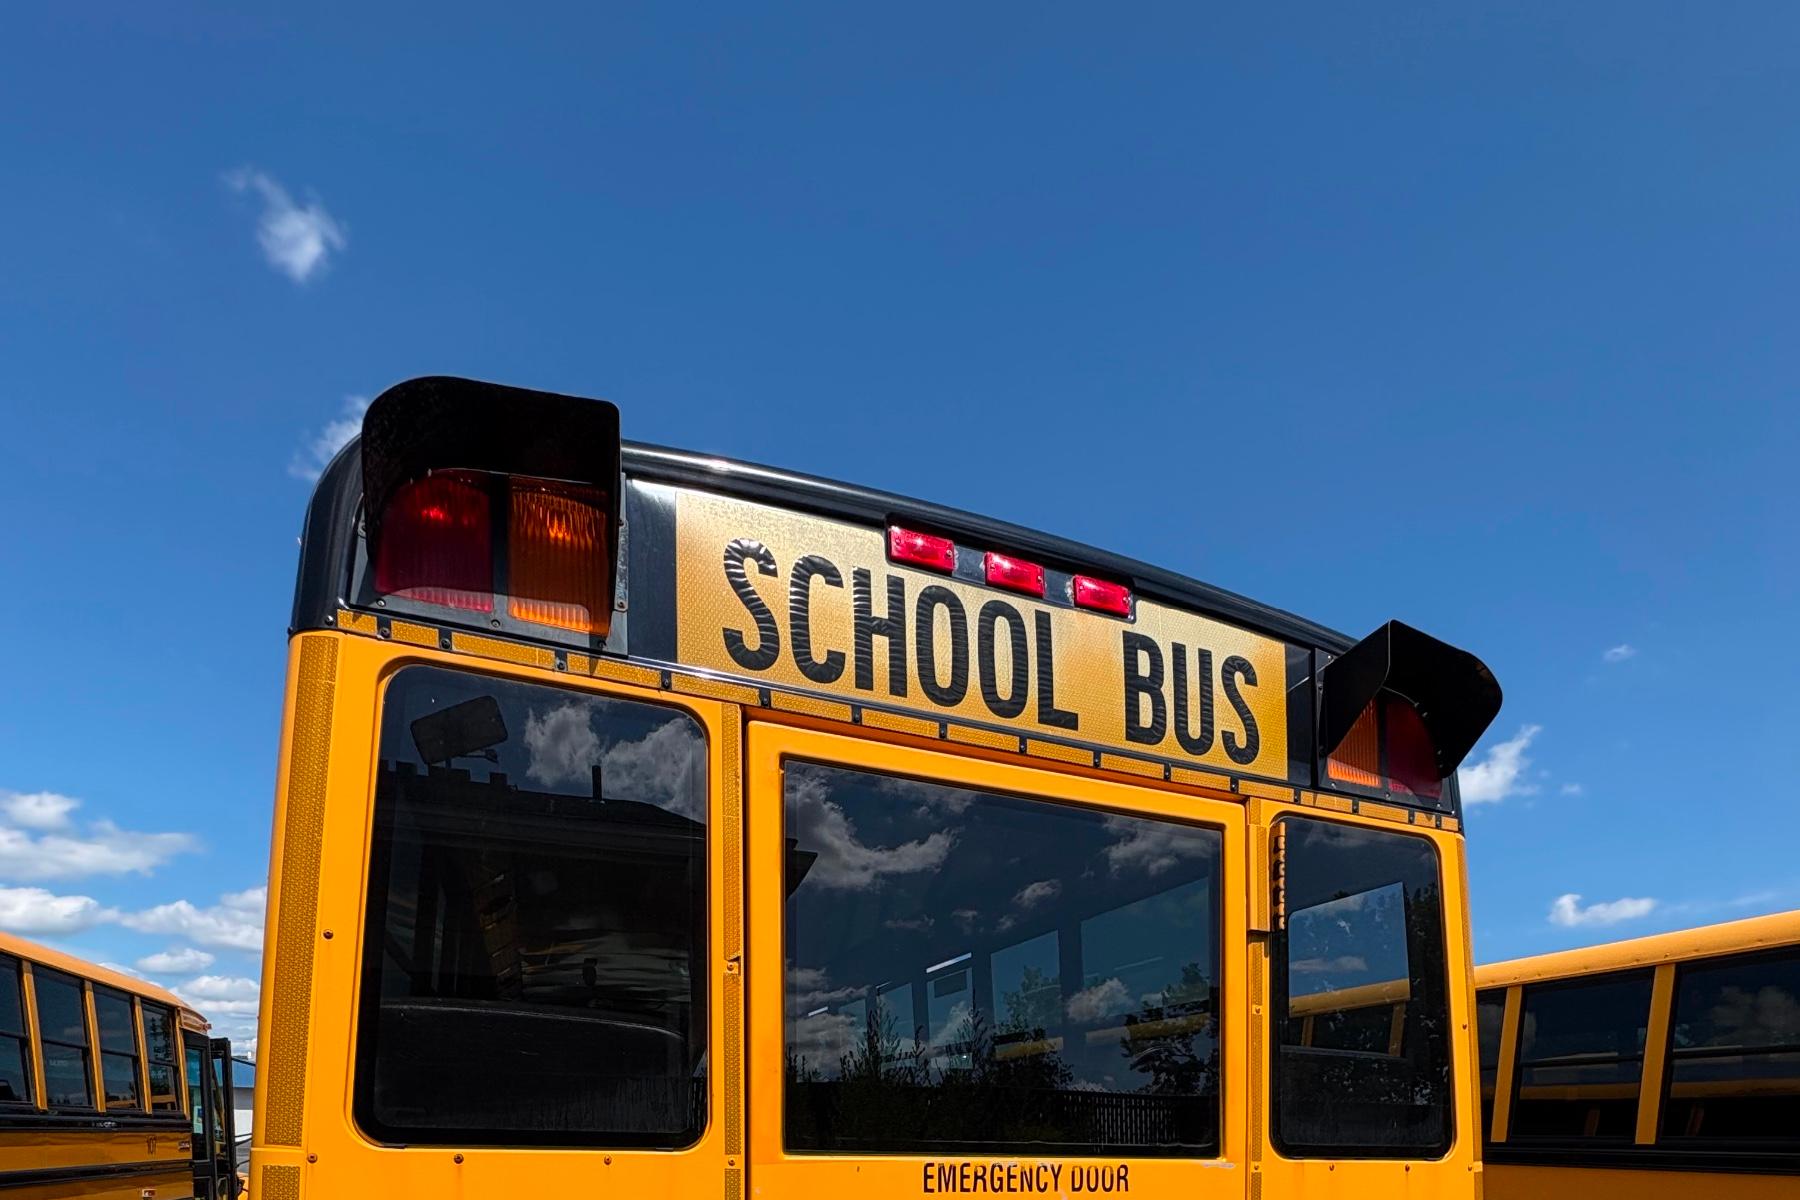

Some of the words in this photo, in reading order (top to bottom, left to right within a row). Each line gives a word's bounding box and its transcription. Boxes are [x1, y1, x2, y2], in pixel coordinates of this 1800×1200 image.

[722, 538, 1079, 731] SCHOOL
[1122, 630, 1260, 765] BUS
[923, 1162, 1063, 1193] EMERGENCY
[1071, 1164, 1129, 1192] DOOR
